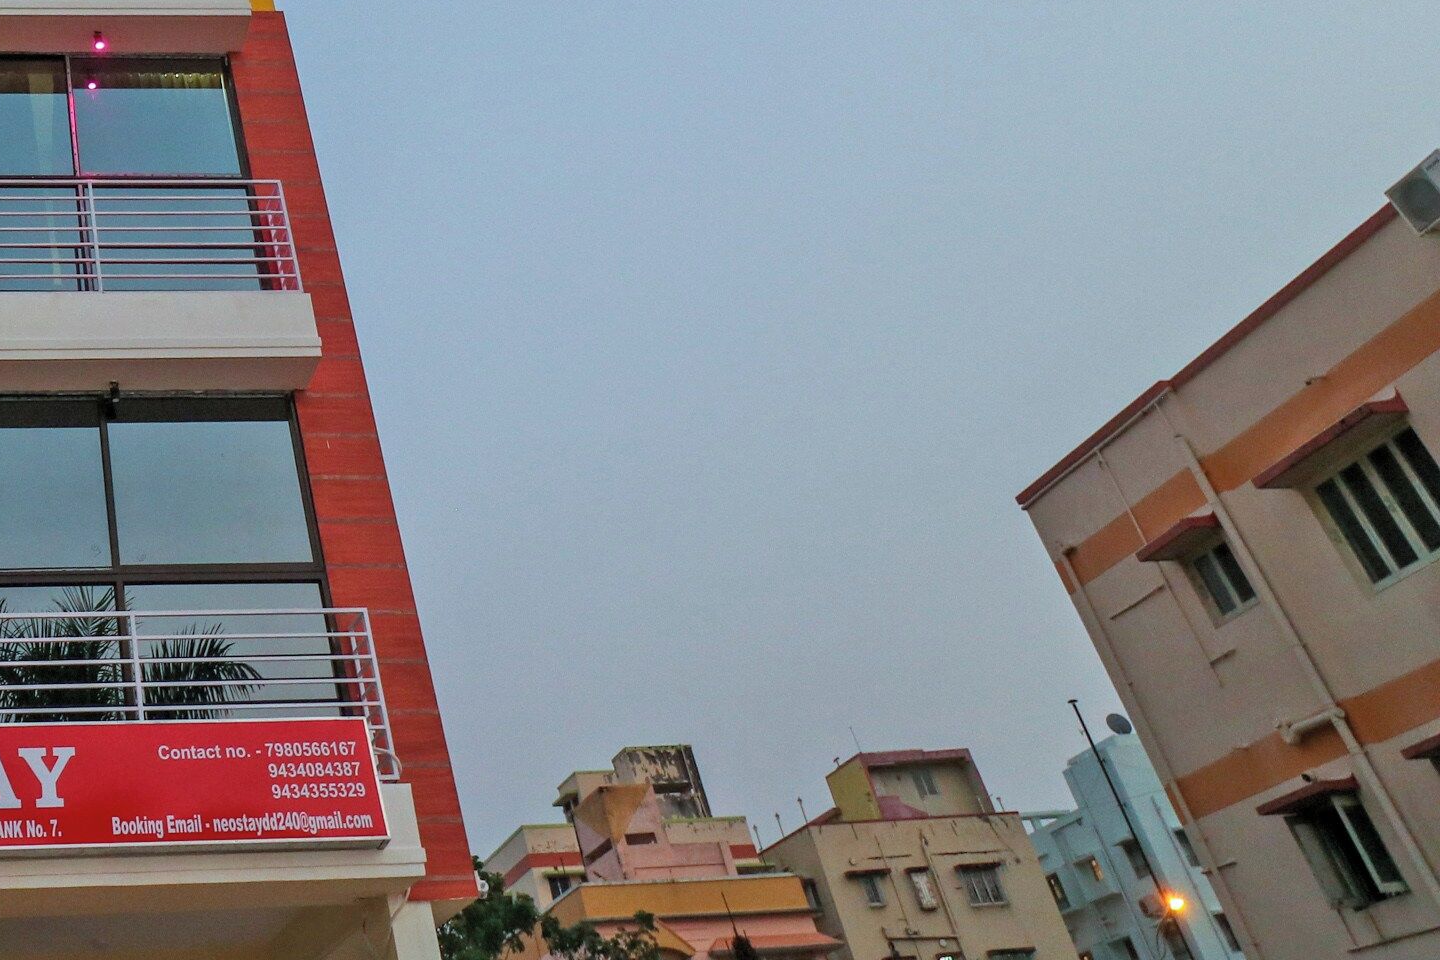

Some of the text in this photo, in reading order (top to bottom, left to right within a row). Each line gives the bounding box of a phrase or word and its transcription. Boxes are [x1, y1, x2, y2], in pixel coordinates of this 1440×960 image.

[157, 745, 221, 760] Contact
[225, 747, 251, 758] no.
[264, 742, 356, 757] 7980566167
[267, 762, 361, 778] 9434084387
[271, 782, 366, 799] 9434355329
[26, 819, 47, 839] No.
[49, 819, 62, 838] 7.
[111, 814, 164, 839] Booking
[167, 814, 203, 835] Email
[212, 810, 374, 836] neostaydd240@gmail.com
